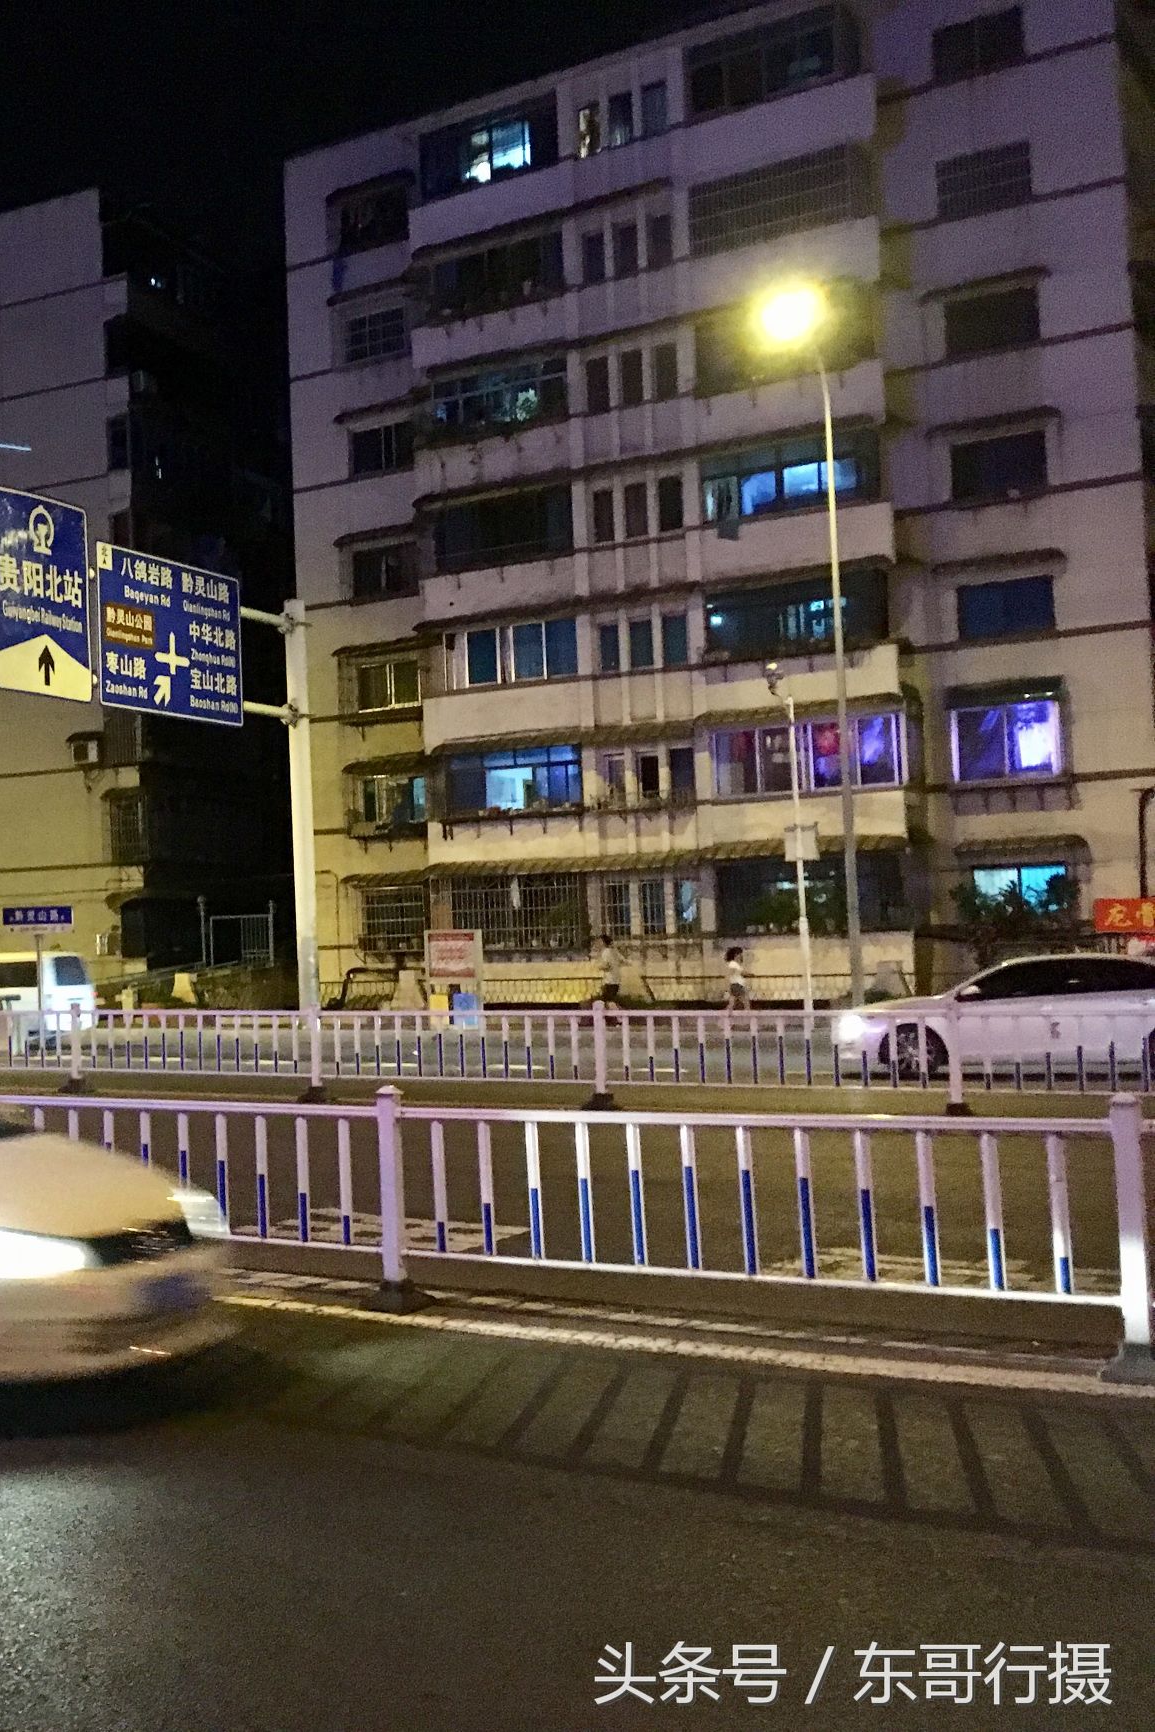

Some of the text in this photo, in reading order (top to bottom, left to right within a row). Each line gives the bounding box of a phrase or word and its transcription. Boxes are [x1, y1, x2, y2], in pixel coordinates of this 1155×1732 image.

[121, 557, 172, 590] 八鸽岩路
[124, 585, 171, 608] Bageyan Rd
[182, 572, 229, 604] 黔灵山路
[107, 606, 152, 632] 黔灵山公园
[189, 620, 236, 651] 中华北路
[106, 651, 146, 680] 枣山路
[106, 680, 148, 699] Zaoshan Rd
[190, 668, 237, 696] 宝山北路
[190, 694, 220, 711] Baoshan
